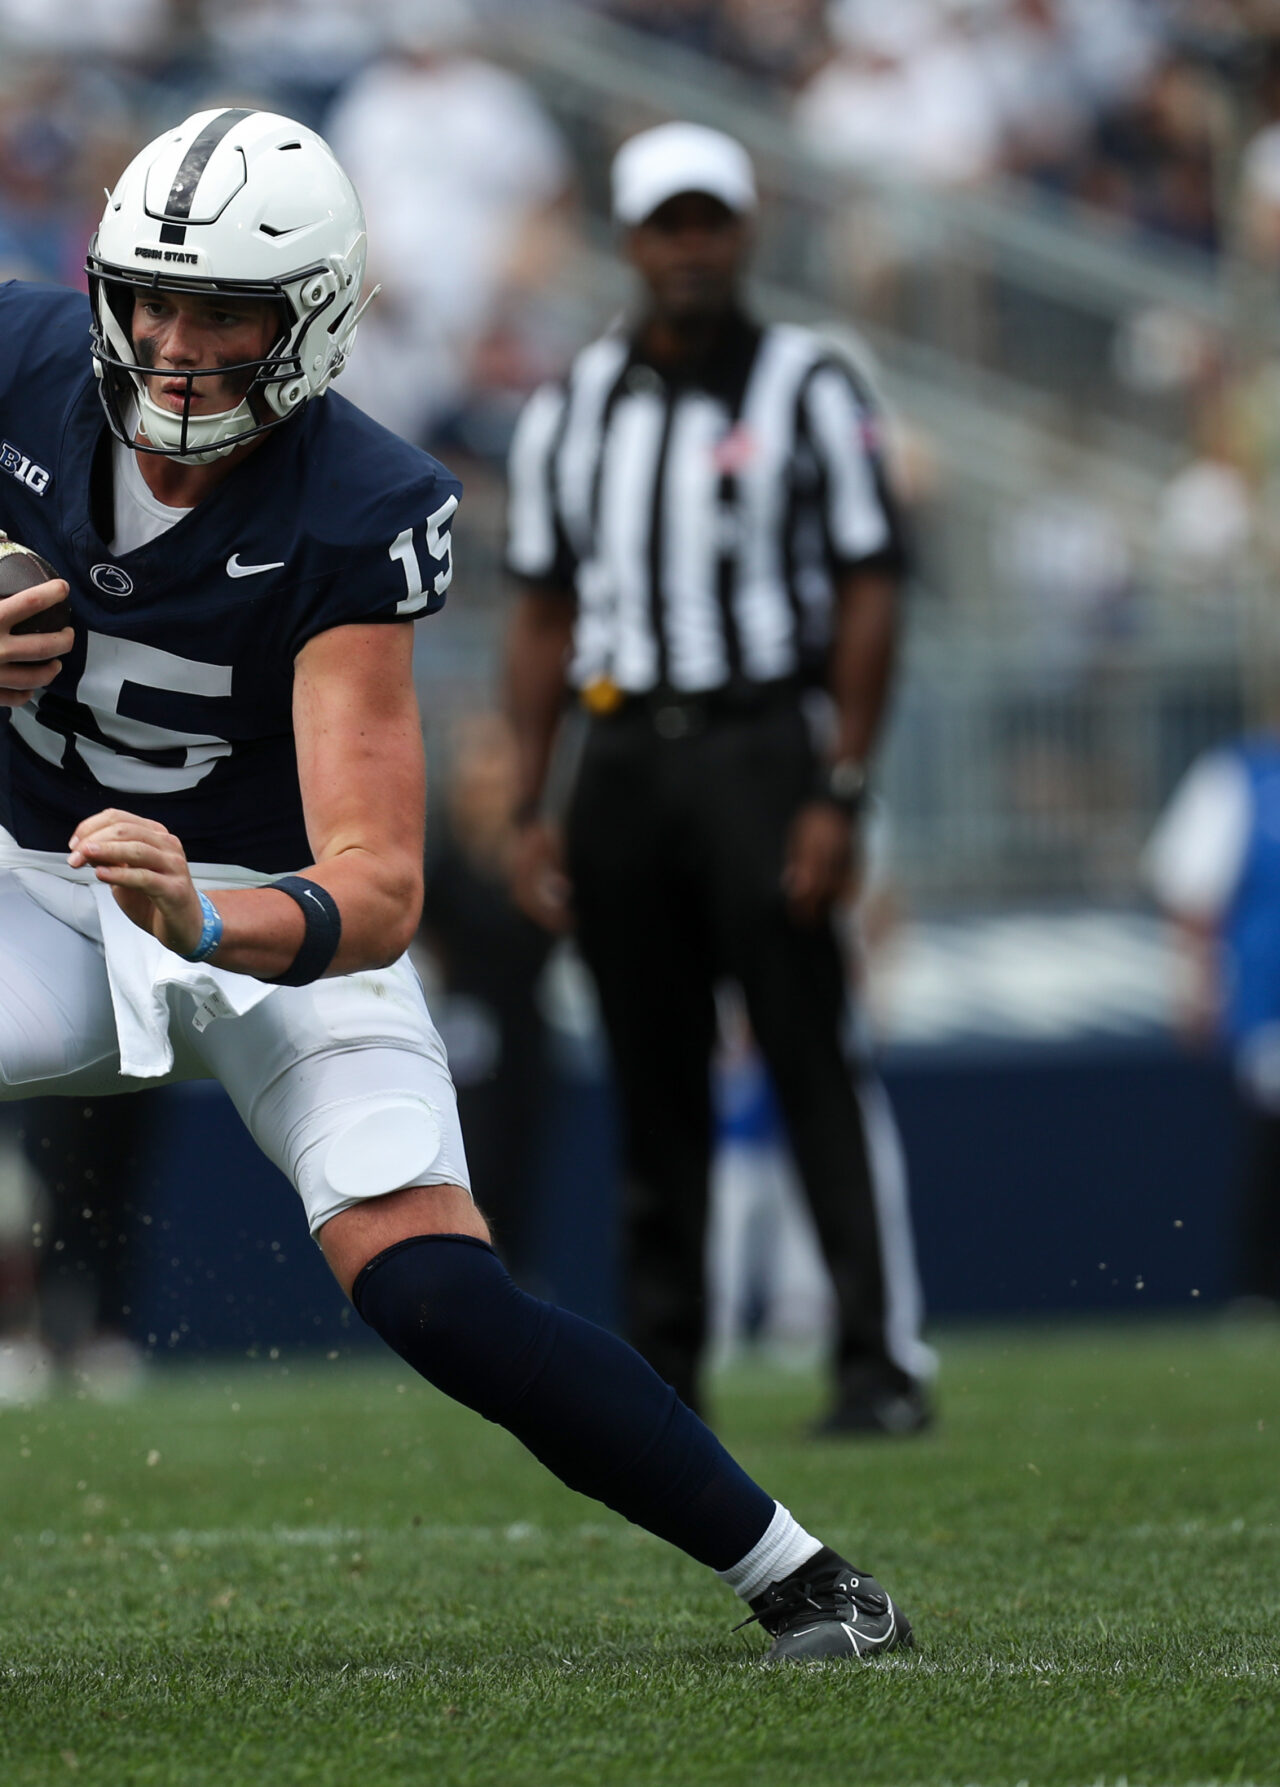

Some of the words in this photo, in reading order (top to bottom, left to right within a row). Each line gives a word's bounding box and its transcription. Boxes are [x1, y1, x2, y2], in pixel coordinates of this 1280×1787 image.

[135, 247, 163, 260] PENN
[164, 251, 199, 264] STATE
[389, 494, 458, 615] 15
